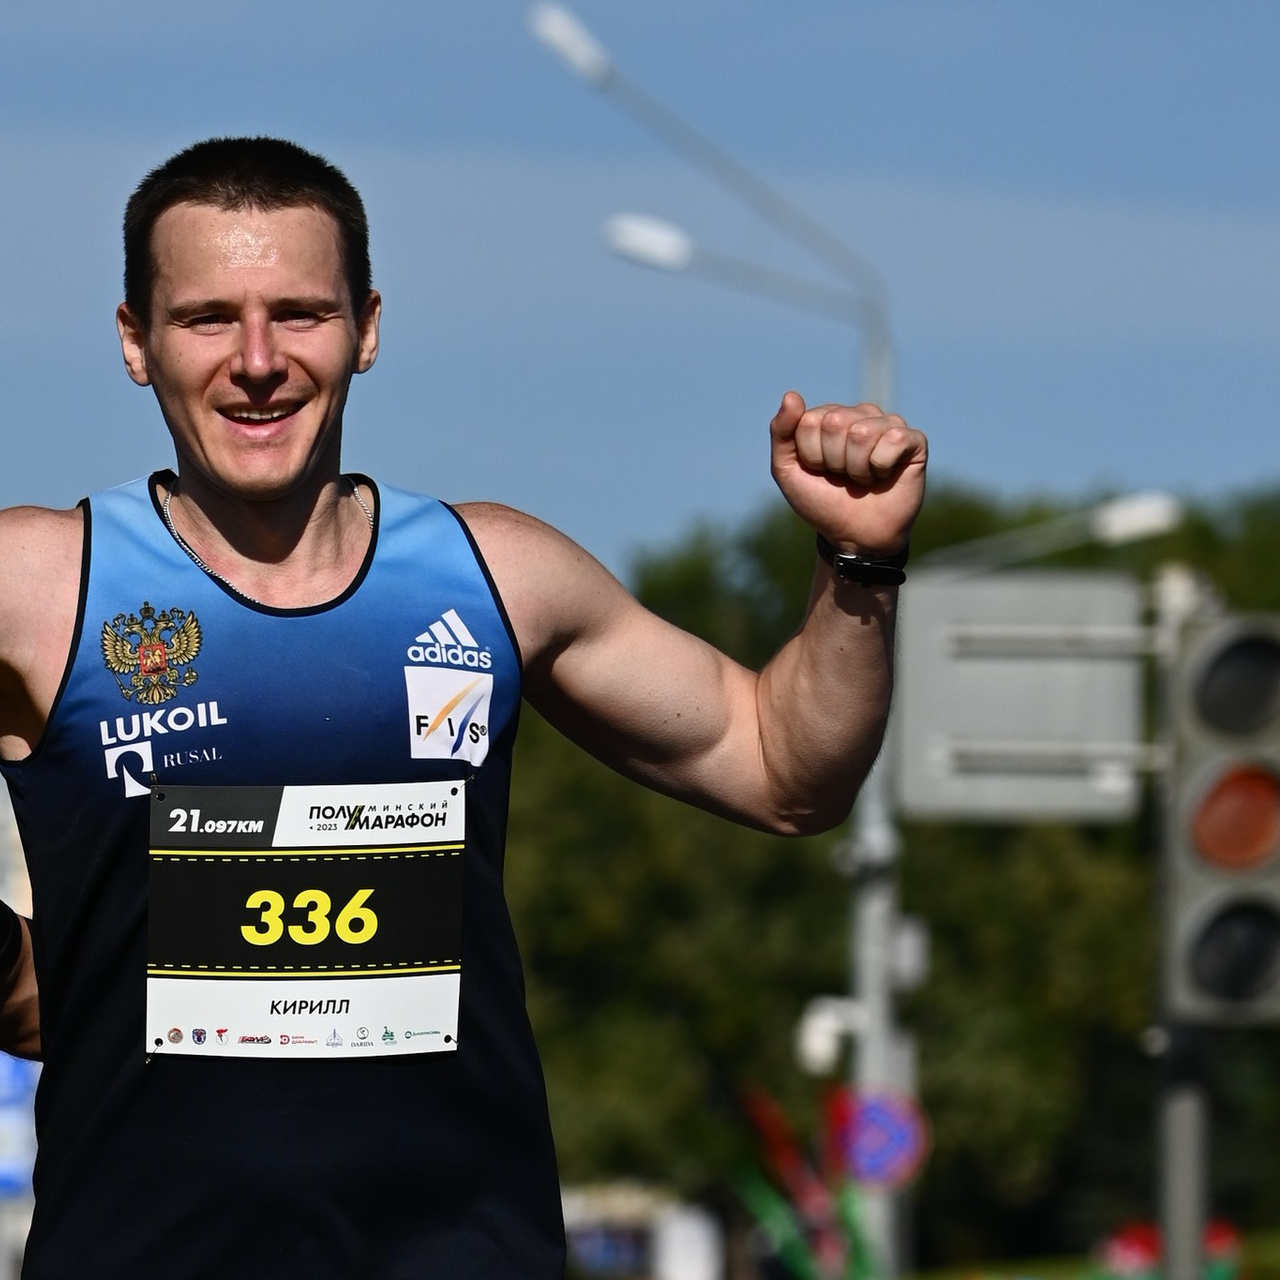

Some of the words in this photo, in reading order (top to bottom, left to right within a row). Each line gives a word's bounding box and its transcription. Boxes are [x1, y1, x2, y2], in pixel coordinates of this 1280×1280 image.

[407, 643, 492, 669] adidas
[100, 701, 228, 745] LUKOIL
[163, 747, 223, 768] RUSAL
[368, 800, 448, 812] МИНСКИЙ
[316, 823, 338, 831] 2023
[349, 812, 447, 830] МАРАФОН
[240, 888, 379, 946] 336
[269, 999, 351, 1015] КИРИЛЛ
